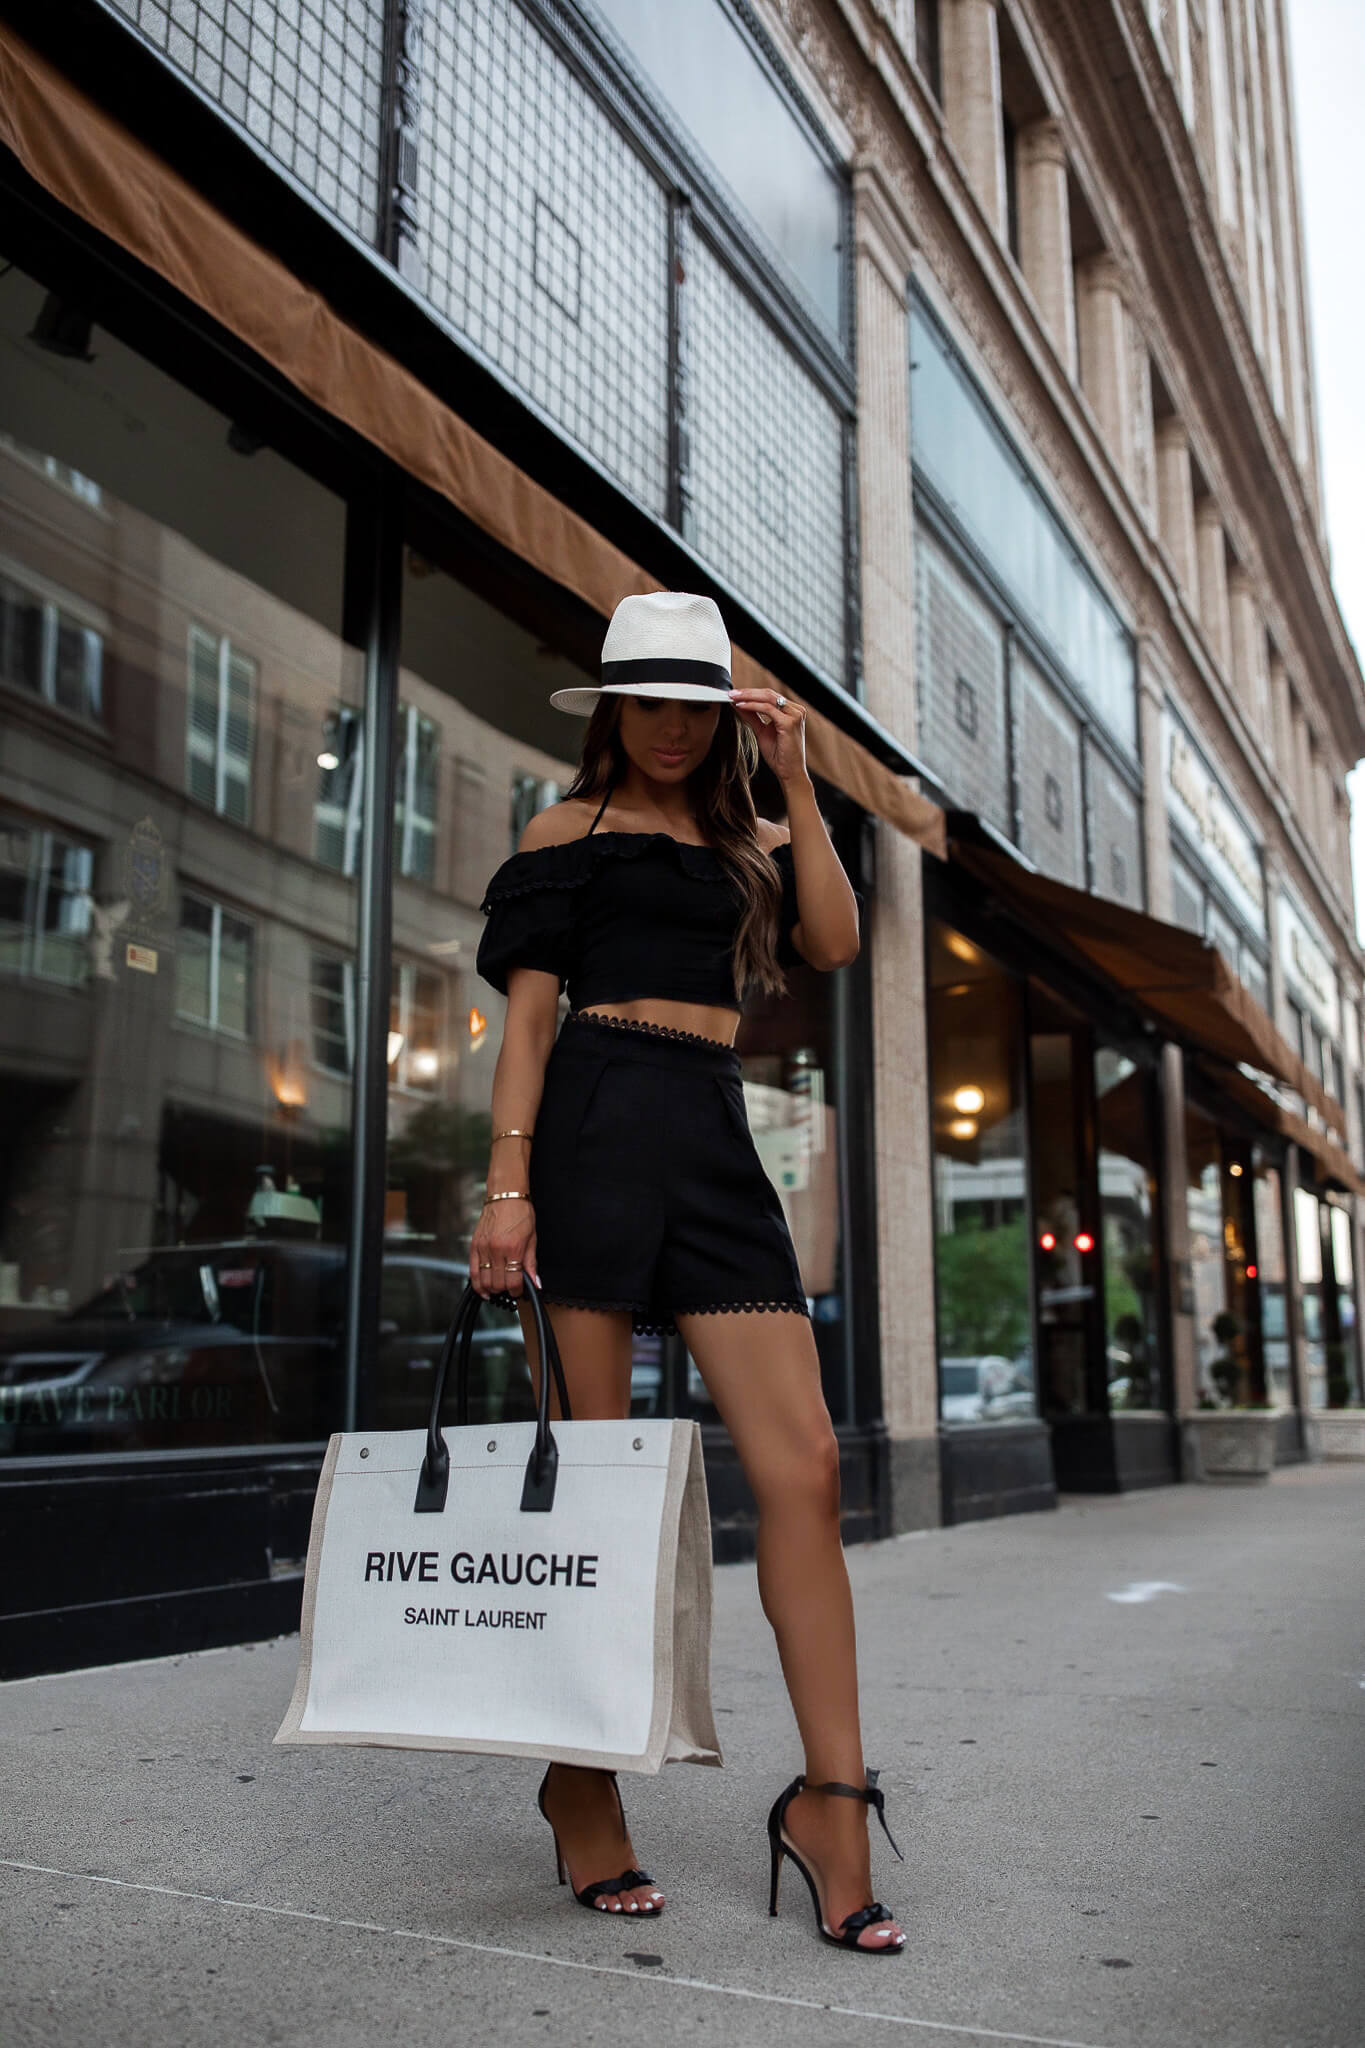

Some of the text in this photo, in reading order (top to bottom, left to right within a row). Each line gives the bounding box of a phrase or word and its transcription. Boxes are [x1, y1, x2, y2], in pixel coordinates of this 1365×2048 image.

[107, 1384, 233, 1422] PARLOR
[364, 1551, 598, 1587] RIVE GAUCHE
[404, 1607, 547, 1630] SAINT LAURENT
